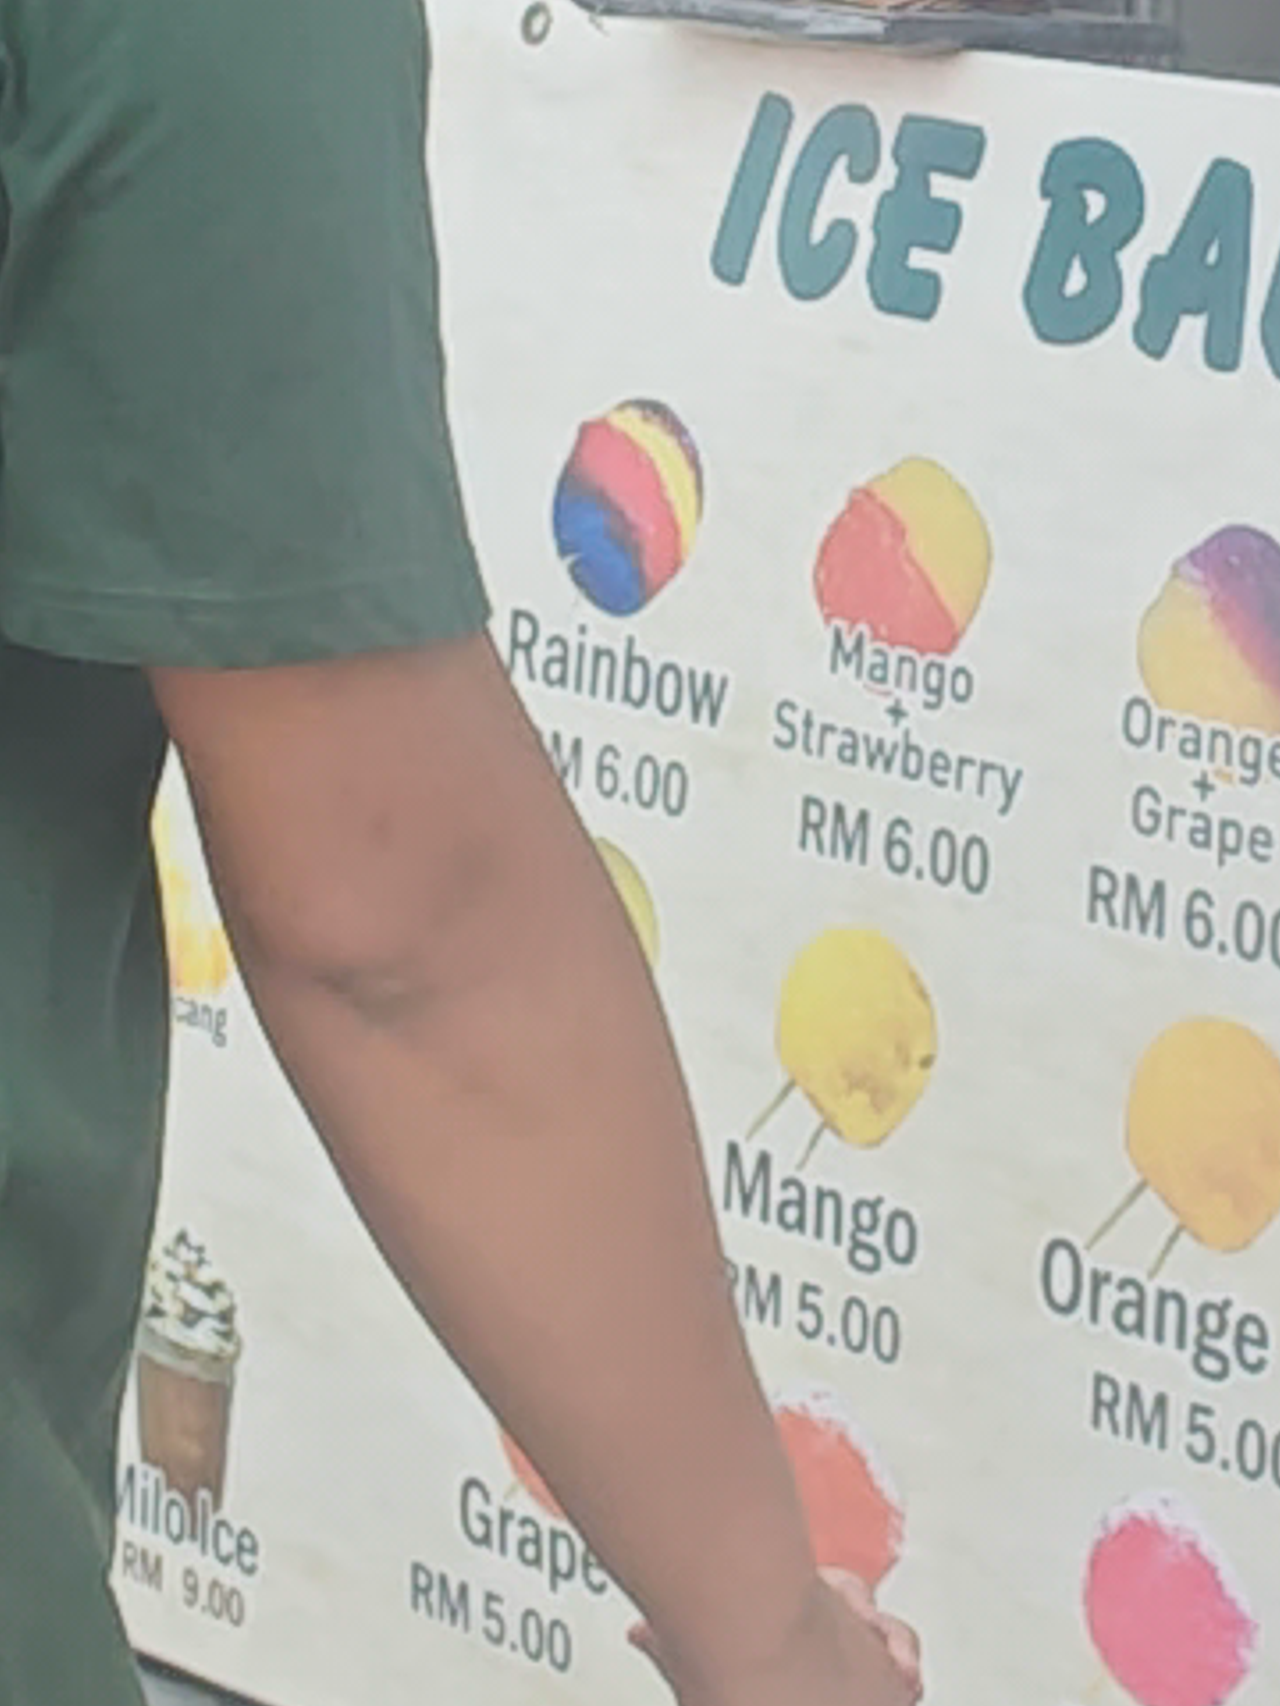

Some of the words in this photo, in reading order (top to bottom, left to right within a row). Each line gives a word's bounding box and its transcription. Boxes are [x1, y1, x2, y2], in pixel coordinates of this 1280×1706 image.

[710, 91, 986, 322] ICE
[509, 608, 730, 728] Rainbow
[828, 628, 976, 708] Mango
[884, 698, 911, 727] +
[595, 743, 690, 818] 6.00
[772, 700, 1024, 816] Strawberry
[1191, 772, 1216, 801] +
[798, 796, 871, 859] RM
[881, 819, 990, 895] 6.00
[1130, 785, 1276, 868] Grape
[1087, 867, 1167, 938] RM
[723, 1139, 918, 1275] Mango
[796, 1281, 901, 1364] 5.00
[1039, 1240, 1270, 1381] Orange
[1090, 1373, 1169, 1452] RM
[199, 1496, 259, 1576] Ice
[460, 1476, 608, 1596] Grape
[123, 1539, 163, 1592] RM
[183, 1566, 245, 1628] 9.00
[410, 1560, 470, 1634] RM
[482, 1589, 571, 1674] 5.00
